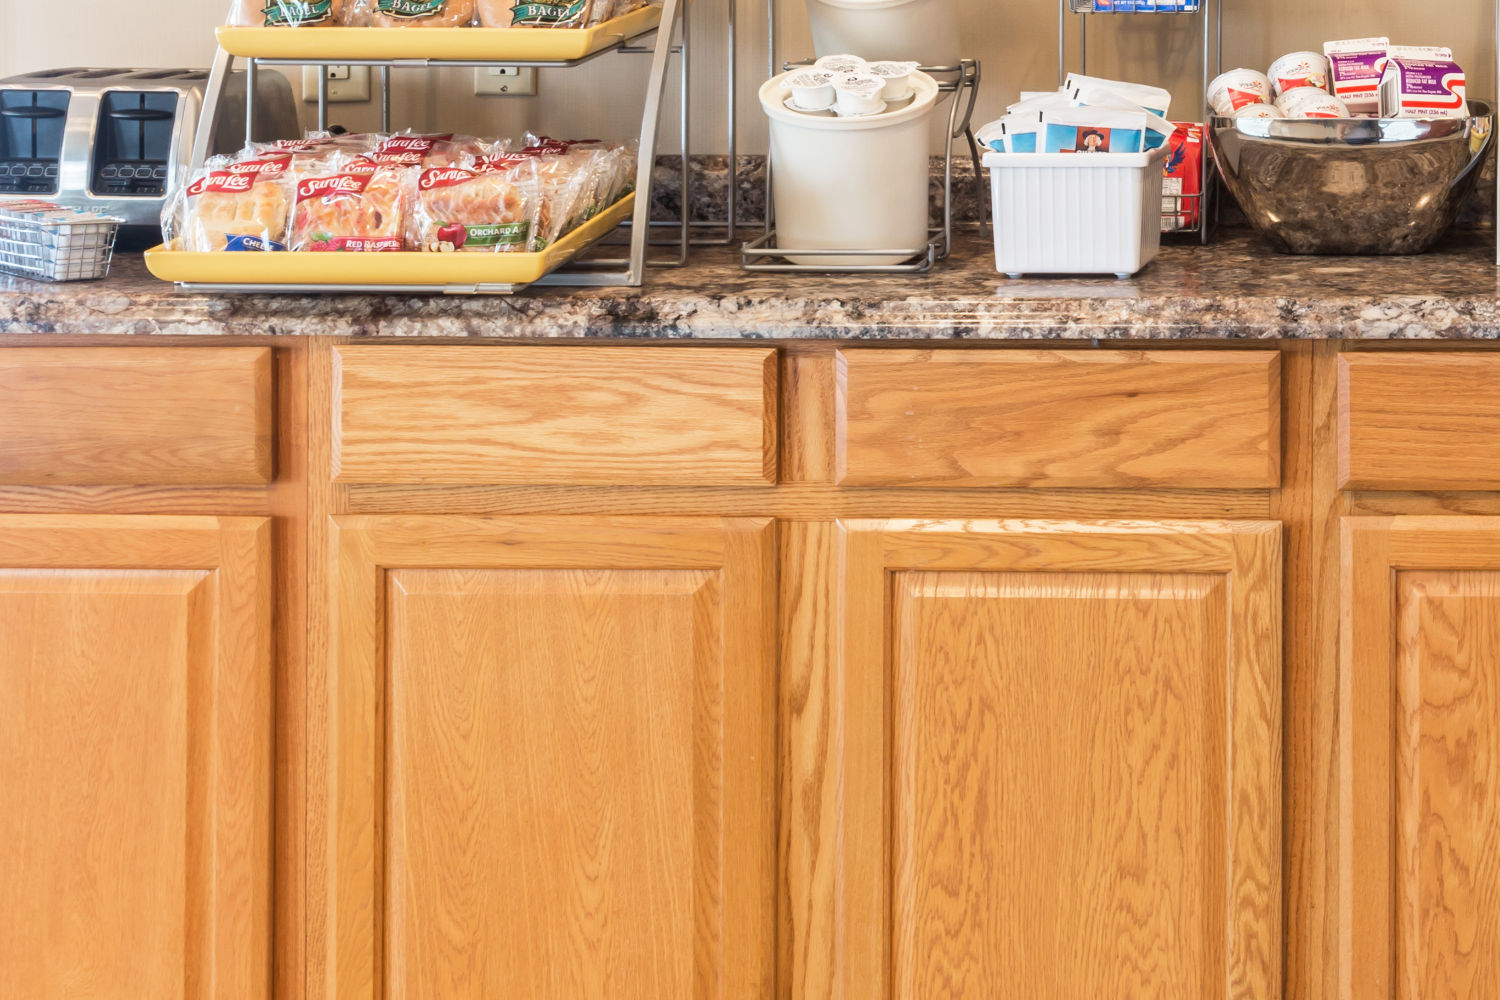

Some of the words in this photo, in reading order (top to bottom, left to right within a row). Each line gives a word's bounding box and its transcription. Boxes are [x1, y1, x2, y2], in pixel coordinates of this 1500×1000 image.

[470, 227, 511, 237] ORCHARD
[242, 237, 274, 250] CHEEE
[346, 240, 362, 248] RED
